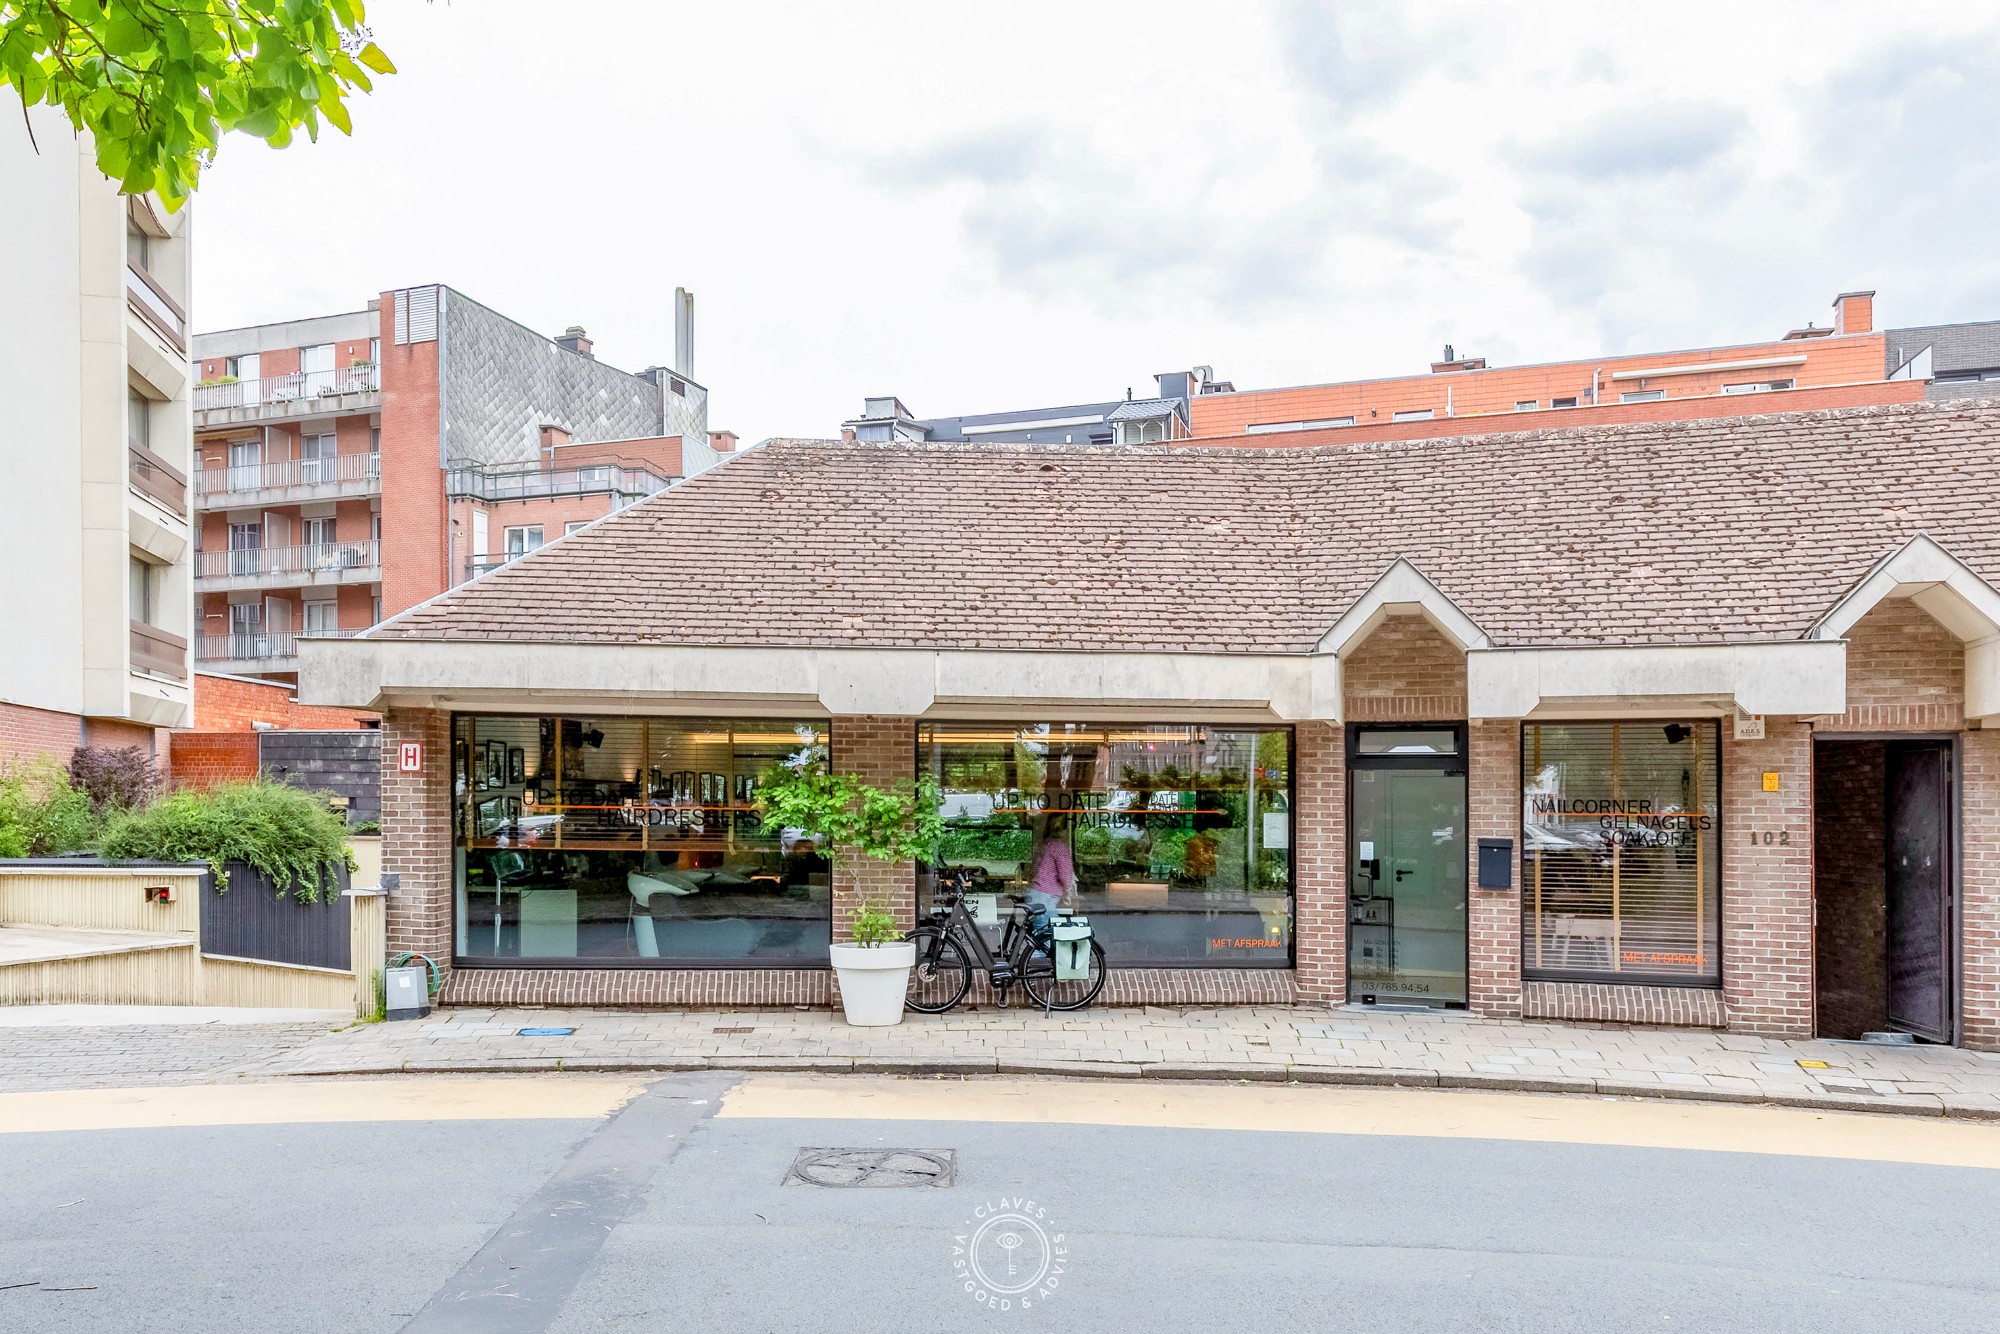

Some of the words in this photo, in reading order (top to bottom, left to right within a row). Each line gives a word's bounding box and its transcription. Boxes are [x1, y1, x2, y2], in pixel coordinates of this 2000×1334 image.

[404, 747, 417, 767] H
[523, 788, 551, 805] UP
[557, 788, 584, 806] TO
[992, 793, 1019, 810] UP
[1024, 793, 1051, 810] TO
[1058, 793, 1106, 811] DATE
[1532, 799, 1652, 814] NAILCORNER
[597, 808, 762, 828] HAIRDRESSERS
[1600, 815, 1712, 831] GELNAGELS
[1600, 830, 1650, 847] SOAK
[1656, 831, 1693, 846] OFF
[1750, 830, 1791, 846] 102
[1212, 938, 1232, 948] MET
[1234, 938, 1282, 948] AFSPRAAK
[1623, 952, 1647, 963] MET
[1650, 953, 1708, 965] AFSPRAAK
[1361, 981, 1430, 993] 03/765.94.54
